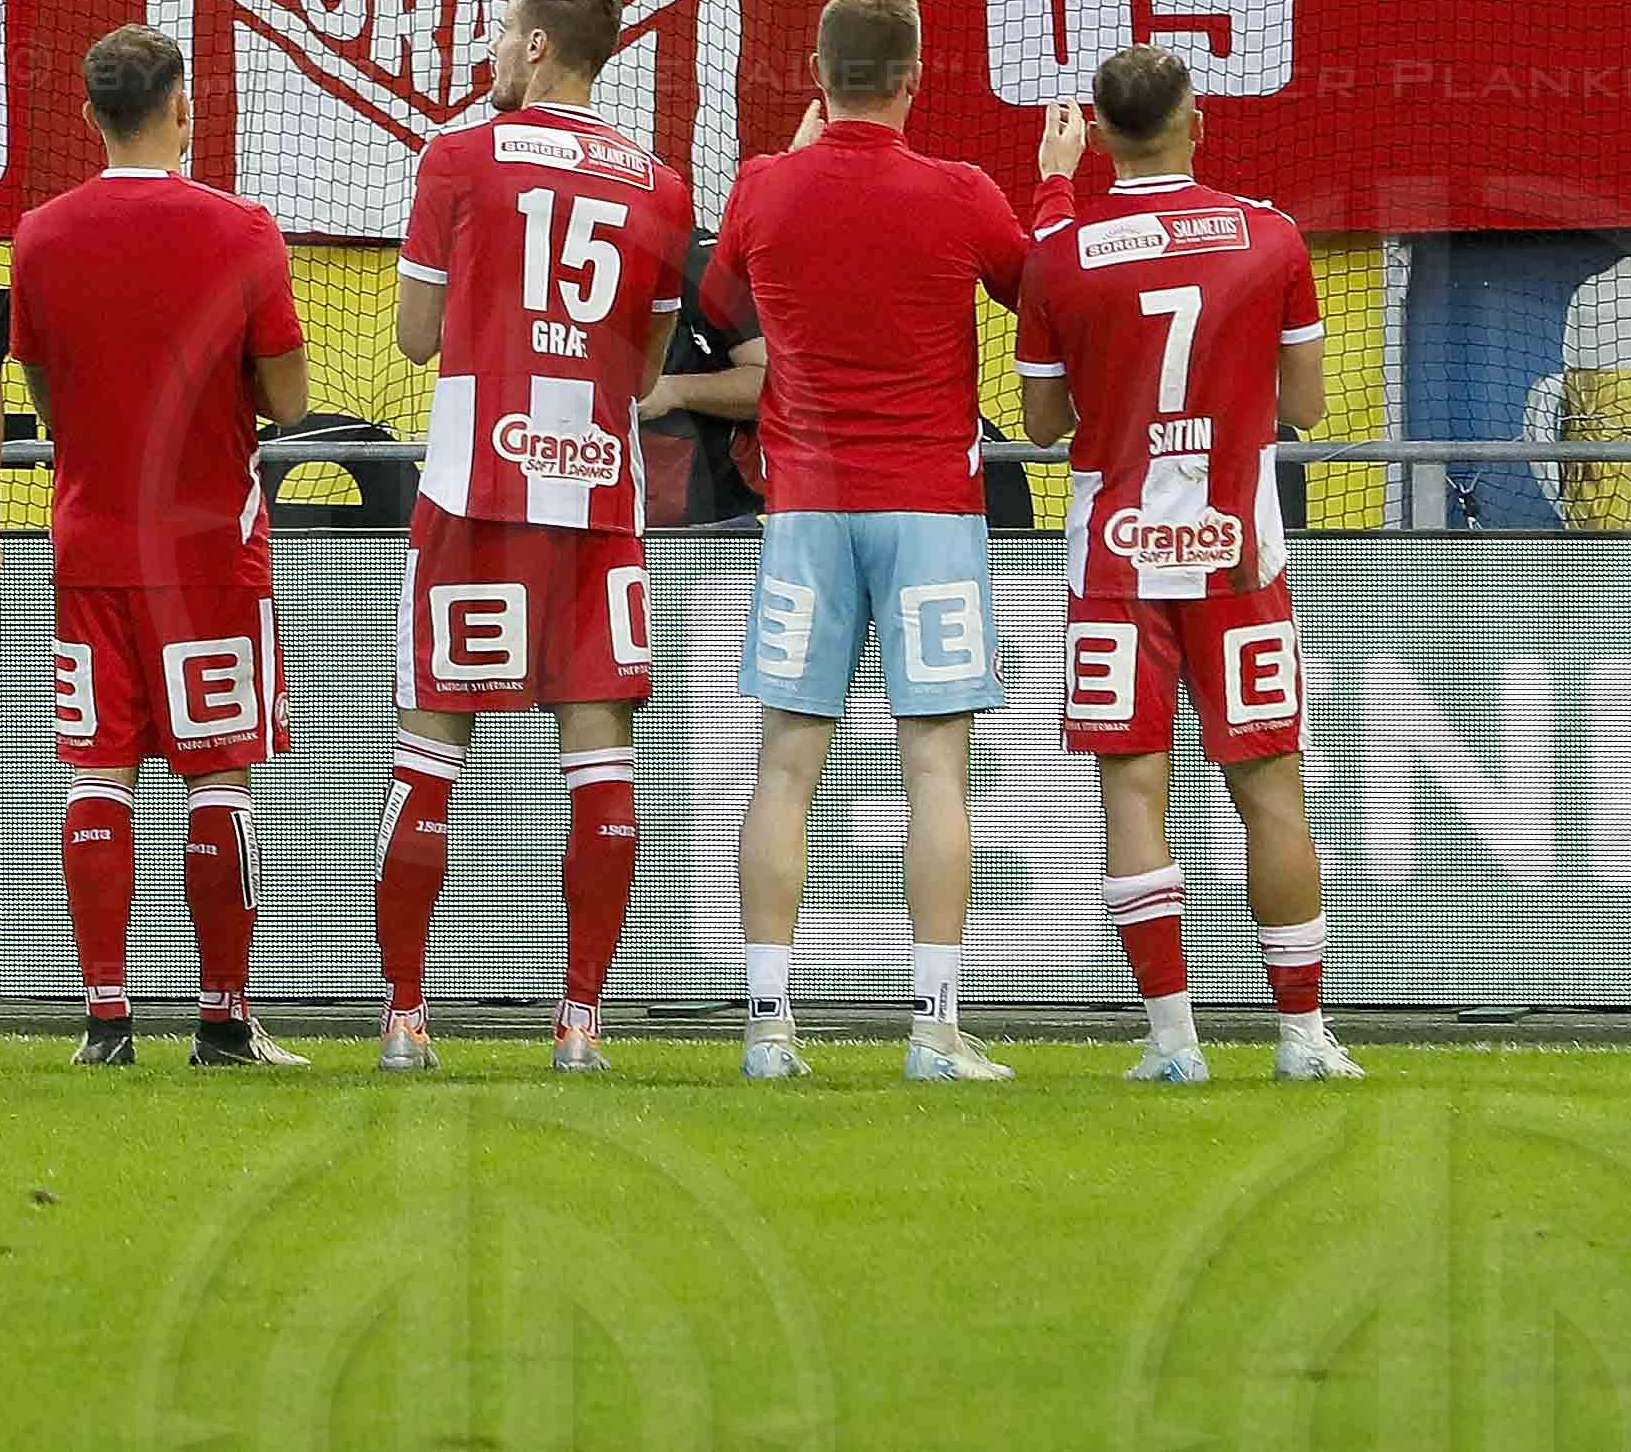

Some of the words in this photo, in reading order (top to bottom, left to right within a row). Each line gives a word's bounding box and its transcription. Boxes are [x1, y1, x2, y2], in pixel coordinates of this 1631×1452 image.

[500, 139, 577, 161] SORGER
[518, 185, 628, 320] 15
[1086, 233, 1163, 257] SORGER
[1172, 215, 1241, 241] SALANETTIS
[1139, 286, 1202, 412] 7
[1148, 418, 1212, 455] SATIN
